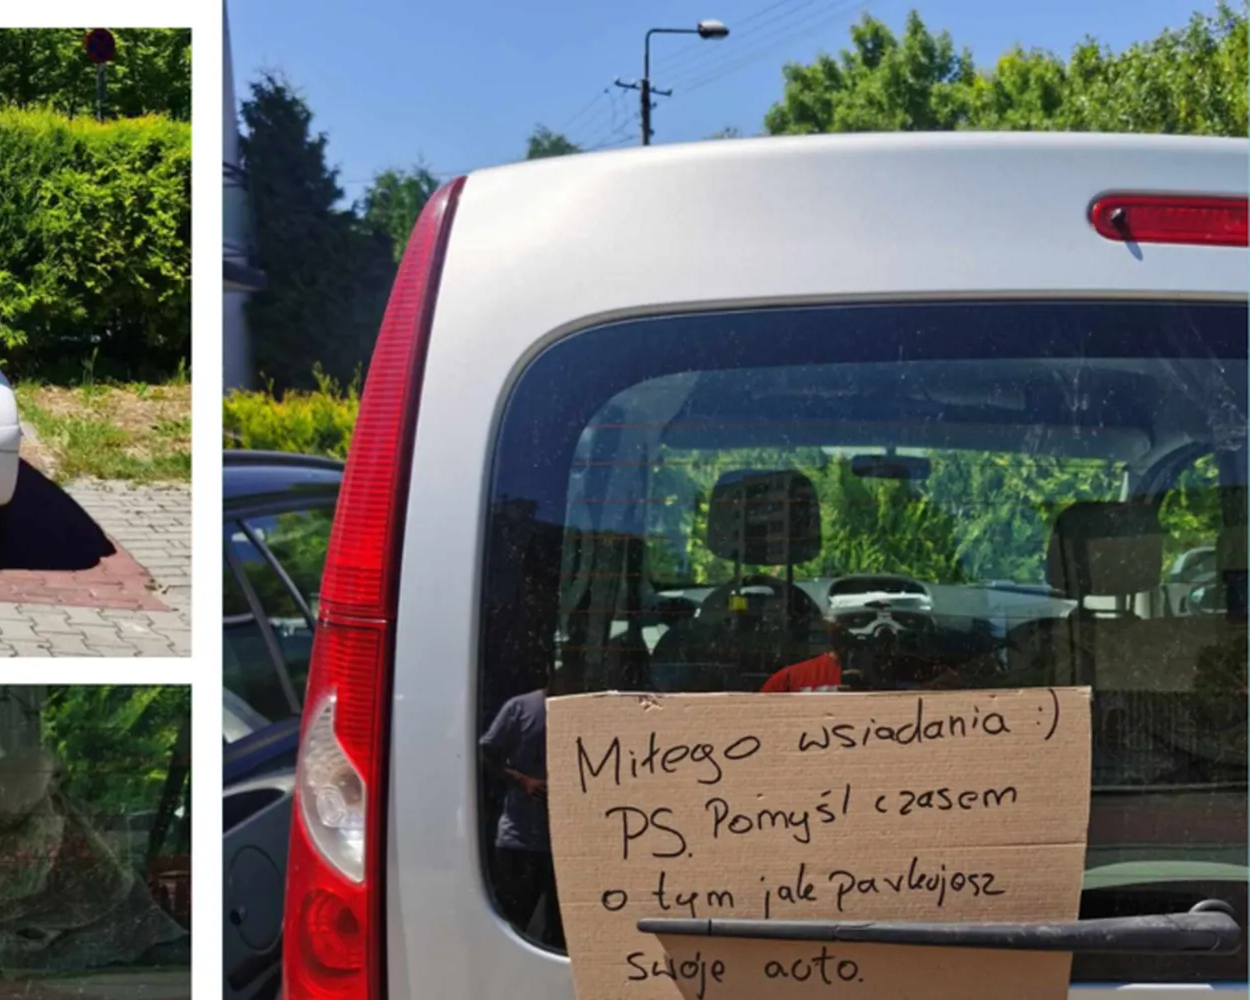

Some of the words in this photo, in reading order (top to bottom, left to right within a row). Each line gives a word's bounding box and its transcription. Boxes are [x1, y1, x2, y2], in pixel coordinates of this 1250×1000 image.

[576, 731, 761, 793] Miłego
[799, 697, 1011, 751] wsiadania
[606, 806, 692, 859] PS.
[705, 783, 850, 843] Pomyśl
[875, 786, 1017, 815] czasem
[601, 889, 628, 912] o
[653, 871, 734, 918] tym
[760, 863, 814, 918] jak
[626, 951, 725, 1000] swoje
[765, 947, 864, 985] auto.
